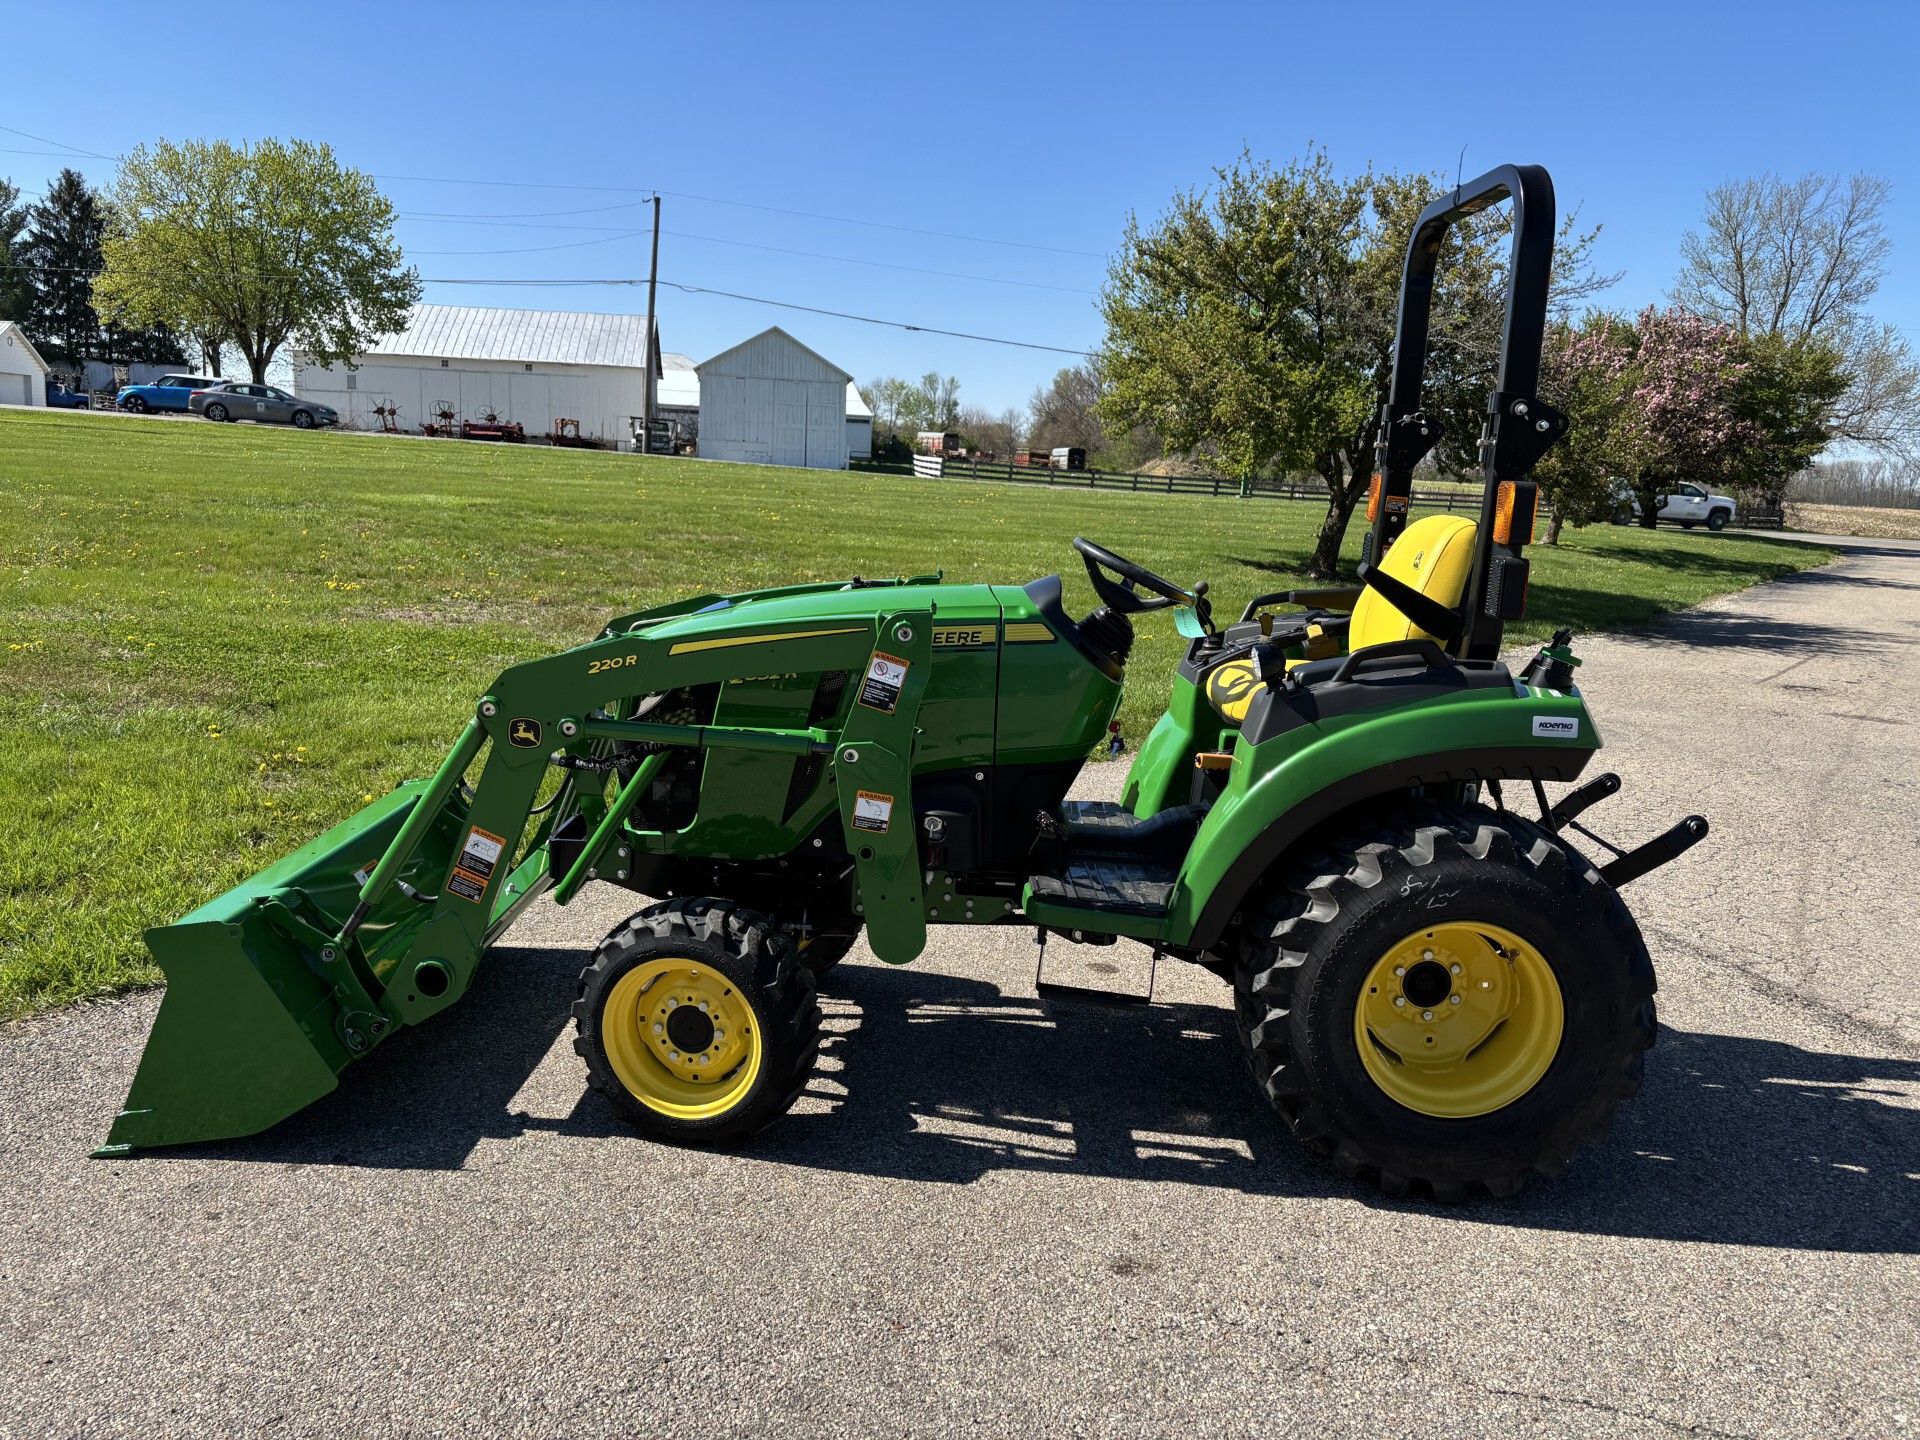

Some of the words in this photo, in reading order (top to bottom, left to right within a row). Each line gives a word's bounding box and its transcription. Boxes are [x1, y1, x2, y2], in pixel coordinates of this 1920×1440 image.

[933, 631, 982, 644] EERE
[880, 653, 908, 667] WARNING
[864, 792, 892, 802] WARNING
[480, 830, 502, 842] WARNING
[462, 872, 484, 885] WARNING
